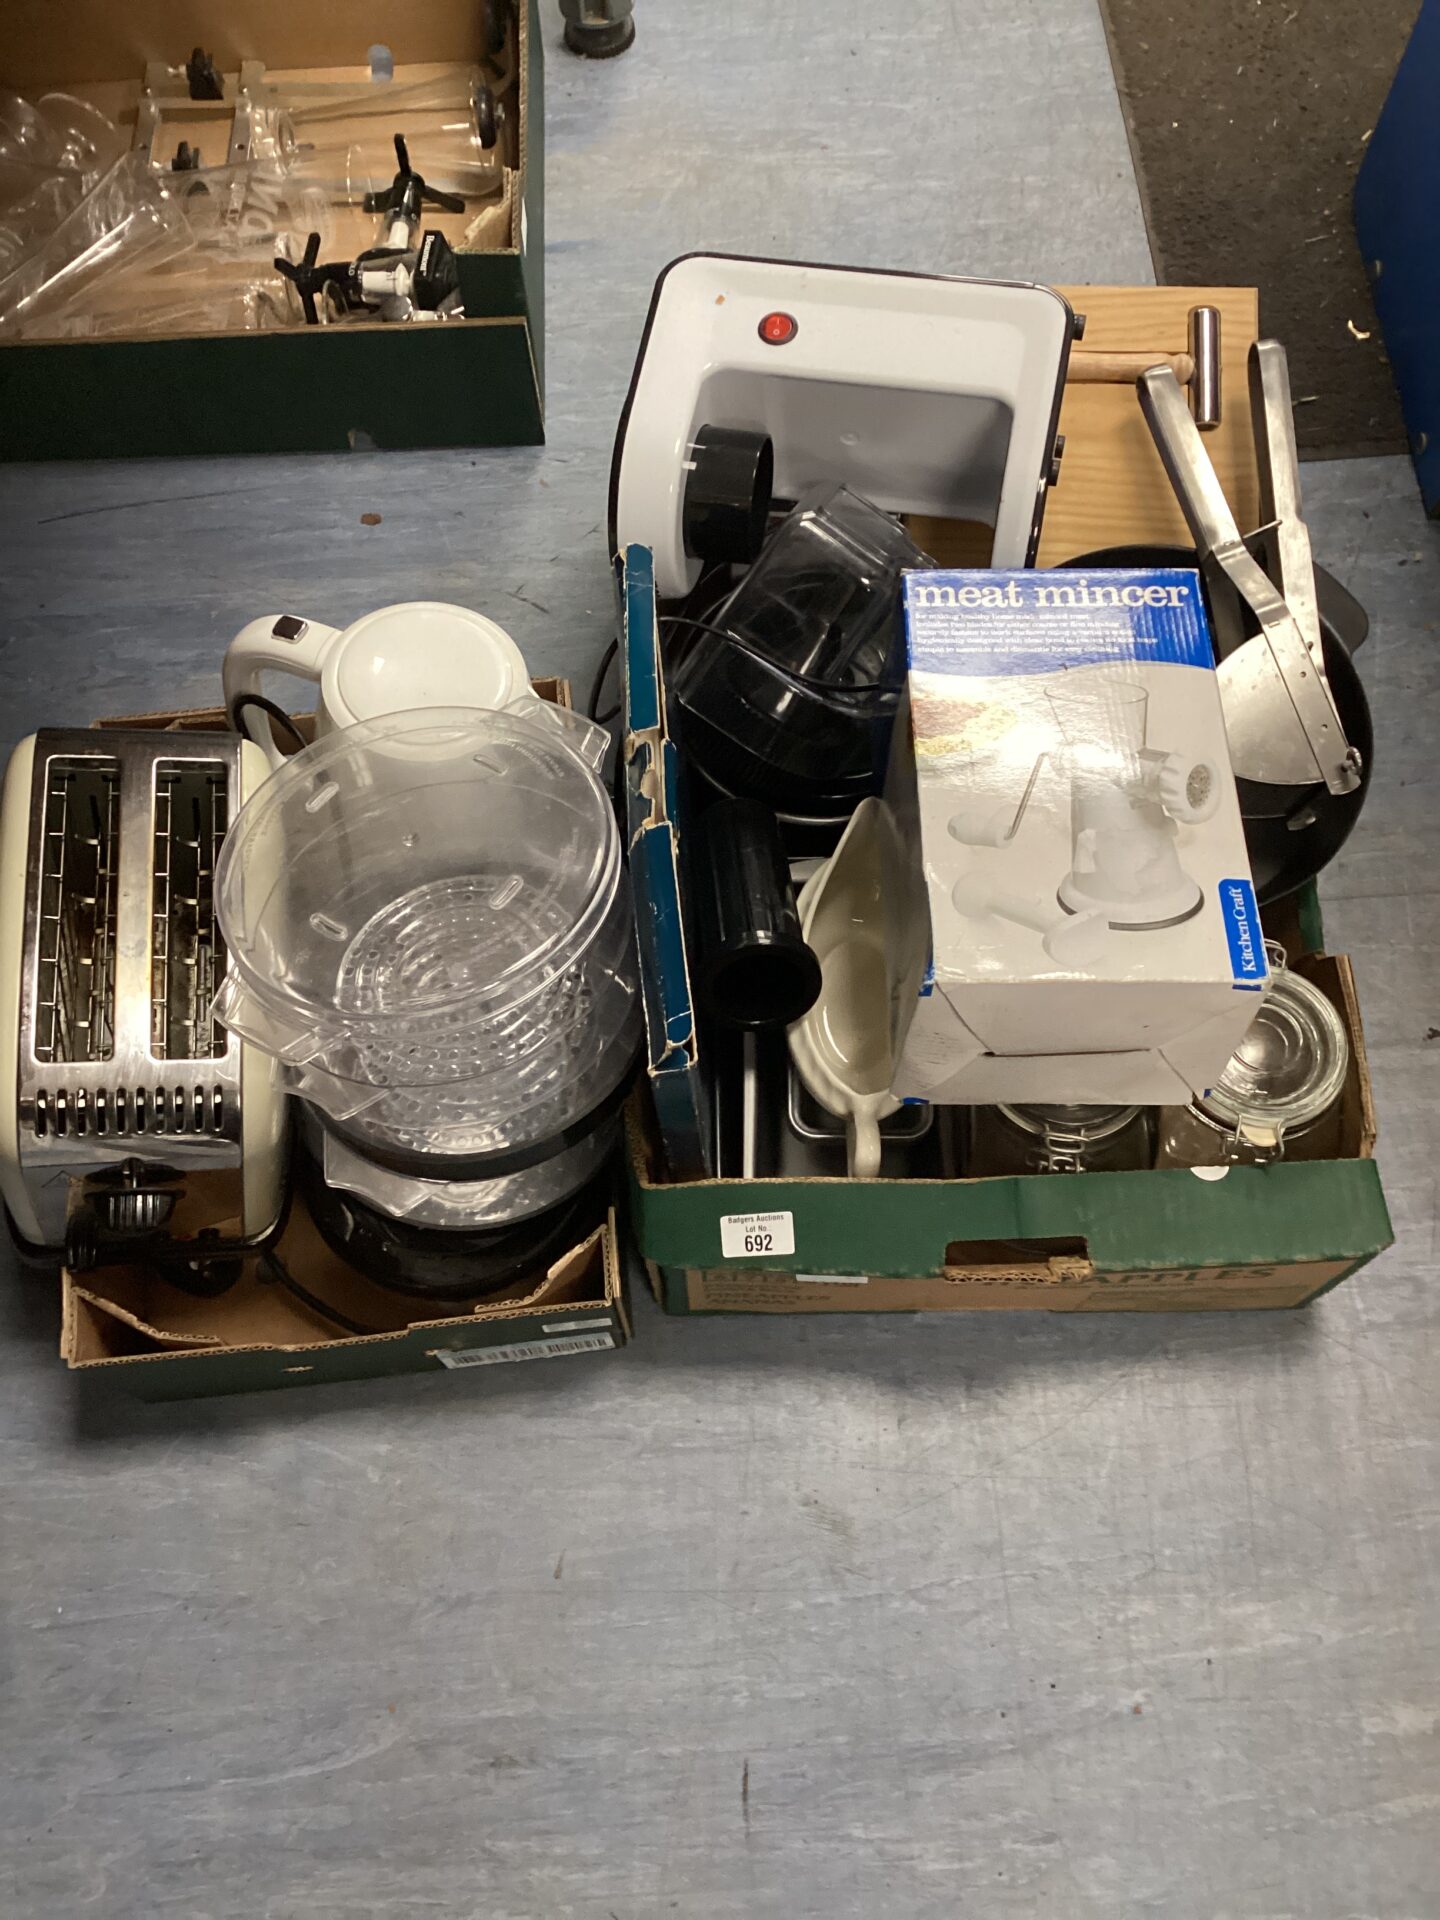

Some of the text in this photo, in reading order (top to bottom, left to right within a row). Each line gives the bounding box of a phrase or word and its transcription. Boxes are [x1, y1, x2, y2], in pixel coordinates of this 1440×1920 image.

[915, 579, 1189, 607] meat mincer
[728, 1214, 784, 1224] Badgers Auctions
[744, 1234, 773, 1252] 692
